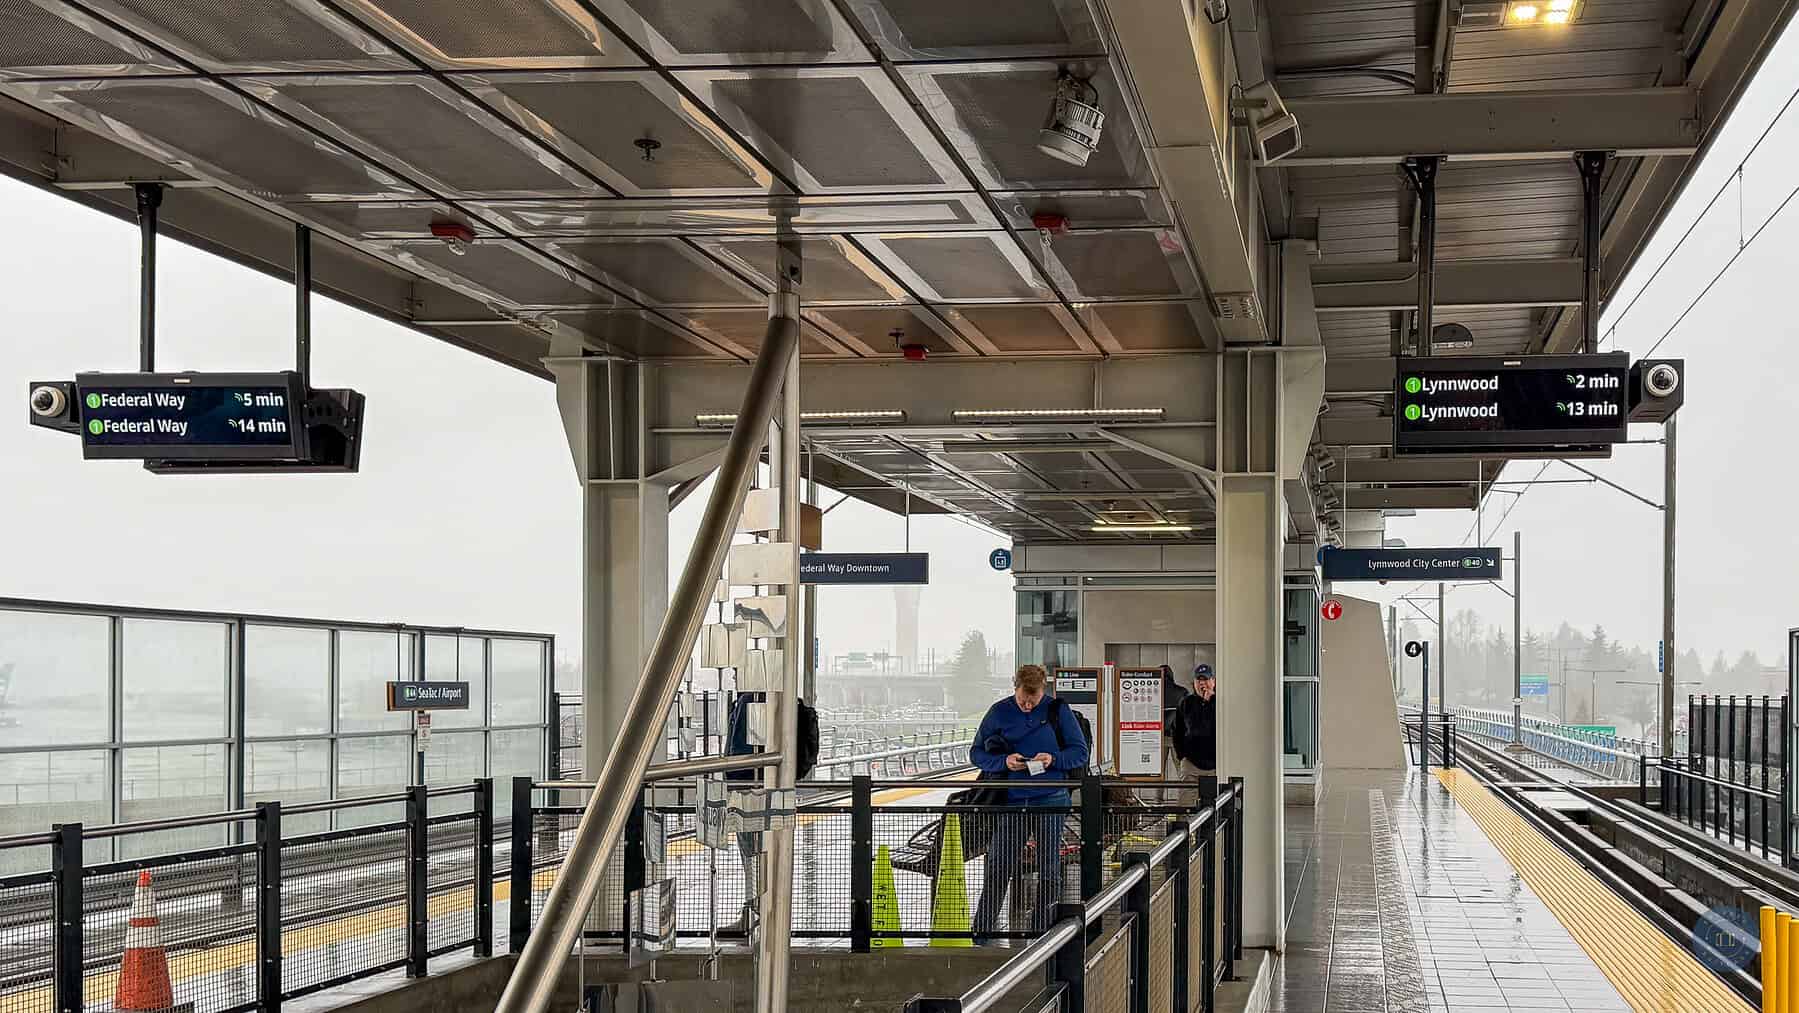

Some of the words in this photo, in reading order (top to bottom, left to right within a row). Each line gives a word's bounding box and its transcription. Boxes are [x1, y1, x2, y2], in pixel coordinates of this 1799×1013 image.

[1422, 375, 1499, 394] Lynnwood
[1575, 375, 1585, 388] 2
[1588, 374, 1619, 388] min
[101, 392, 153, 407] Federal
[155, 393, 186, 411] Way
[243, 393, 253, 406] 5
[255, 392, 284, 406] min
[1421, 402, 1498, 421] Lynnwood
[1566, 402, 1585, 415] 13
[1588, 401, 1618, 415] min
[103, 418, 155, 433] Federal
[157, 419, 188, 437] Way
[238, 419, 256, 432] 14
[257, 418, 286, 432] min
[800, 562, 826, 573] ederal
[827, 563, 845, 575] Way
[846, 563, 890, 573] Downtown
[1368, 558, 1411, 571] Lynnwood
[1412, 558, 1430, 570] City
[1431, 558, 1460, 568] Center
[1409, 643, 1417, 655] 4
[442, 687, 462, 701] Airport
